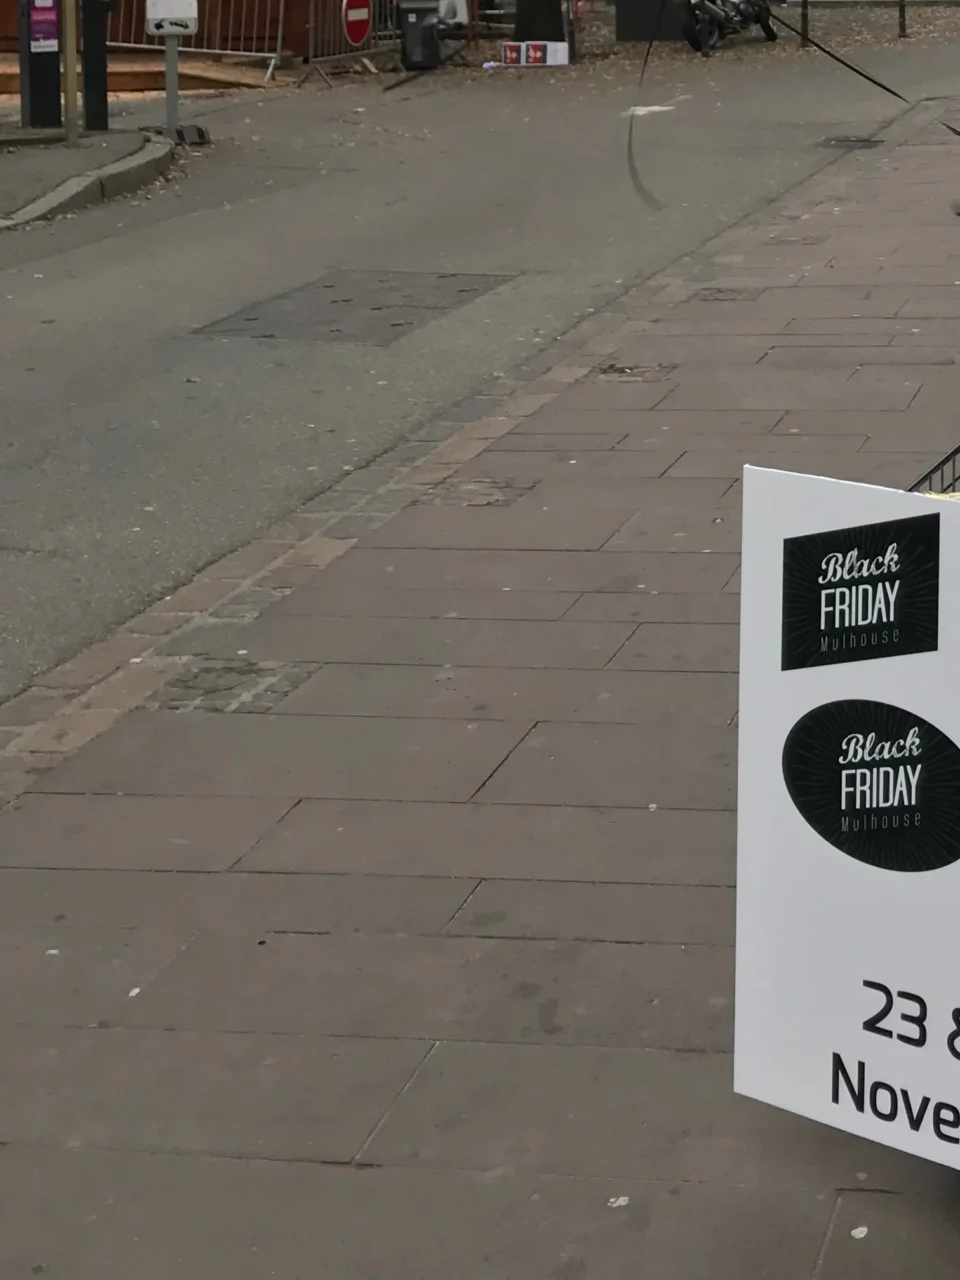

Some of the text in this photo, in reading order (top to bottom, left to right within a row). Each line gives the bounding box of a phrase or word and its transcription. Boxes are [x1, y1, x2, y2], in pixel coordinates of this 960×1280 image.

[818, 542, 901, 584] Black
[820, 579, 901, 630] FRIDAY
[820, 628, 900, 652] Mulhouse
[838, 726, 923, 764] Black
[841, 763, 923, 810] FRIDAY
[841, 812, 922, 832] Mulhouse
[862, 979, 928, 1048] 23
